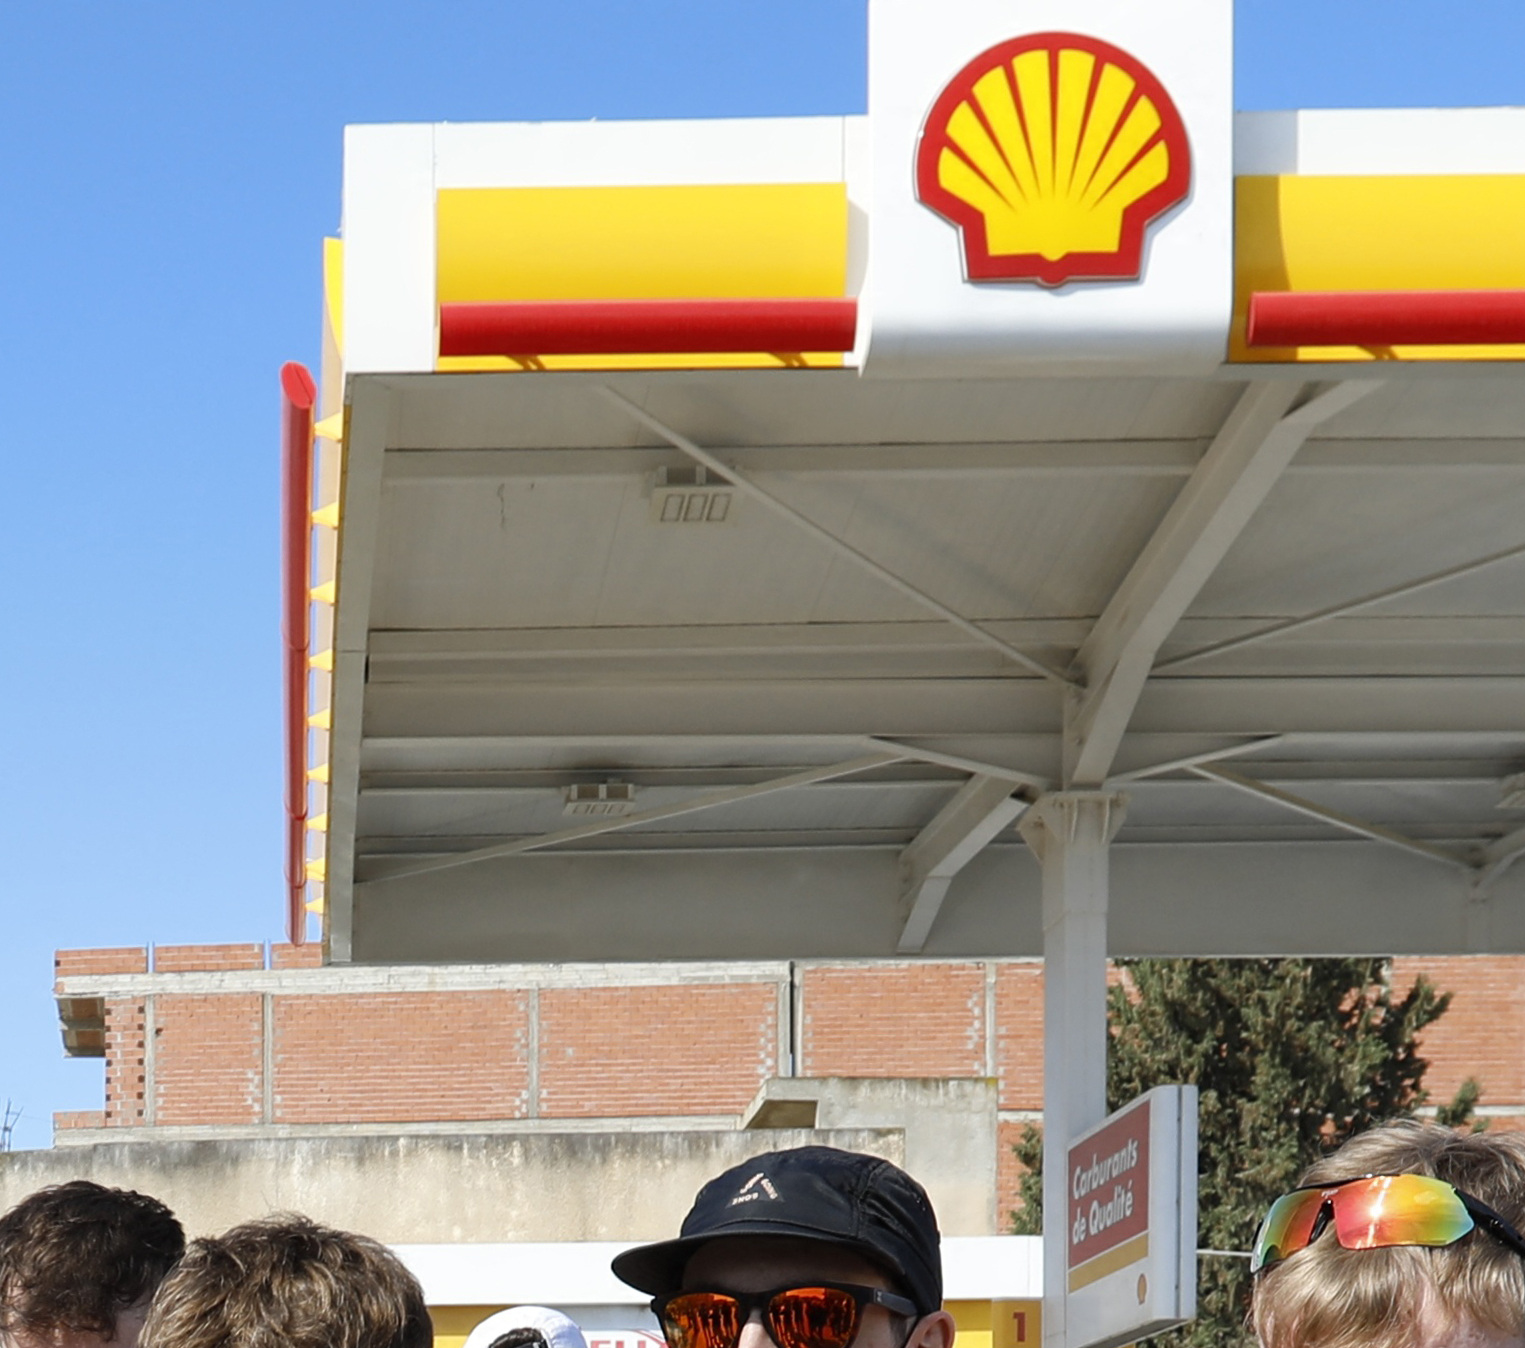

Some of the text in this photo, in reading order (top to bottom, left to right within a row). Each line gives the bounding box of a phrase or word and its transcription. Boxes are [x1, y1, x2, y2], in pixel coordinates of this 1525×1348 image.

[1073, 1138, 1138, 1200] Carburants
[1073, 1180, 1133, 1245] de Qualité
[1013, 1312, 1025, 1342] 1
